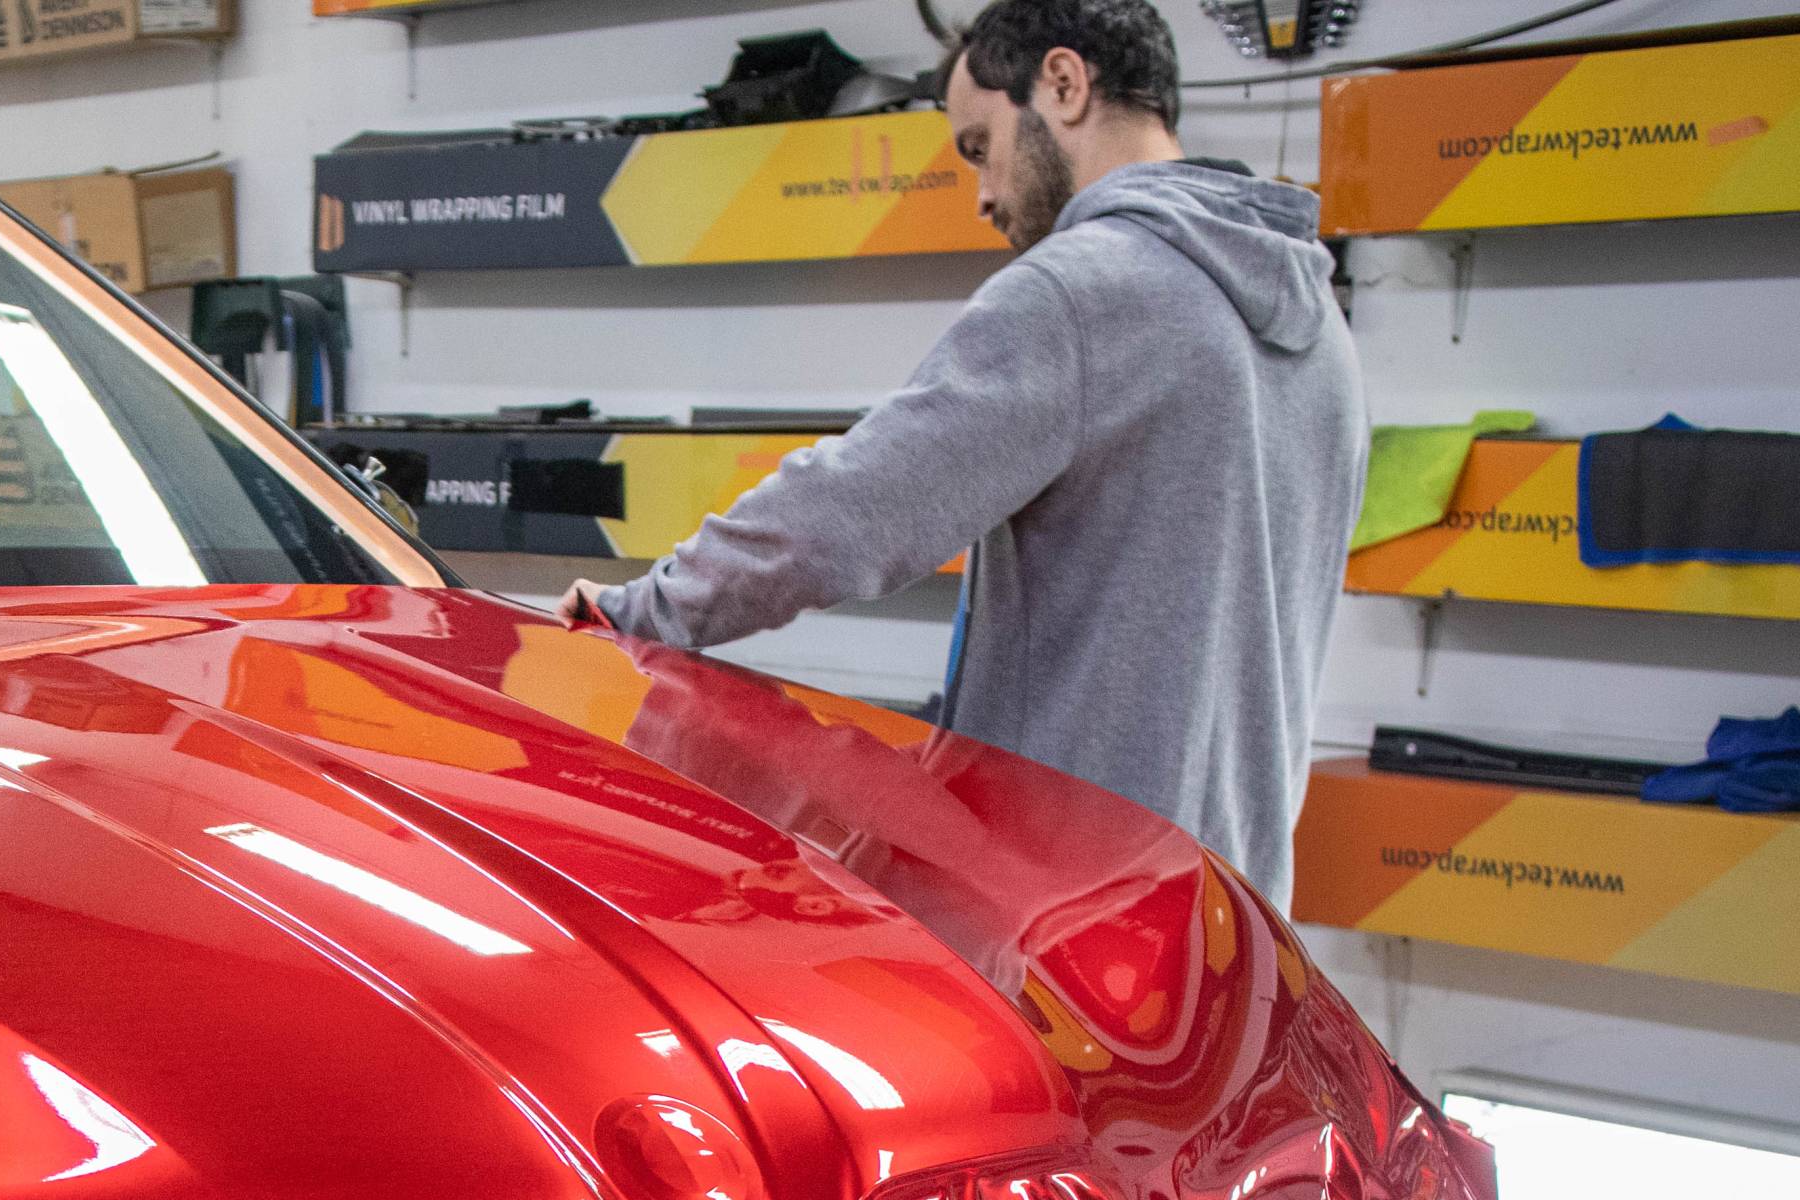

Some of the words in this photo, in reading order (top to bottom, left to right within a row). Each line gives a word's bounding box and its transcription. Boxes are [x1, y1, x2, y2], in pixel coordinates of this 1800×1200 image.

[1438, 122, 1698, 159] www.teckwrap.com
[352, 199, 408, 224] VINYL
[410, 196, 513, 221] WRAPPING
[516, 192, 566, 218] FILM
[1381, 846, 1625, 893] www.teckwrap.com
